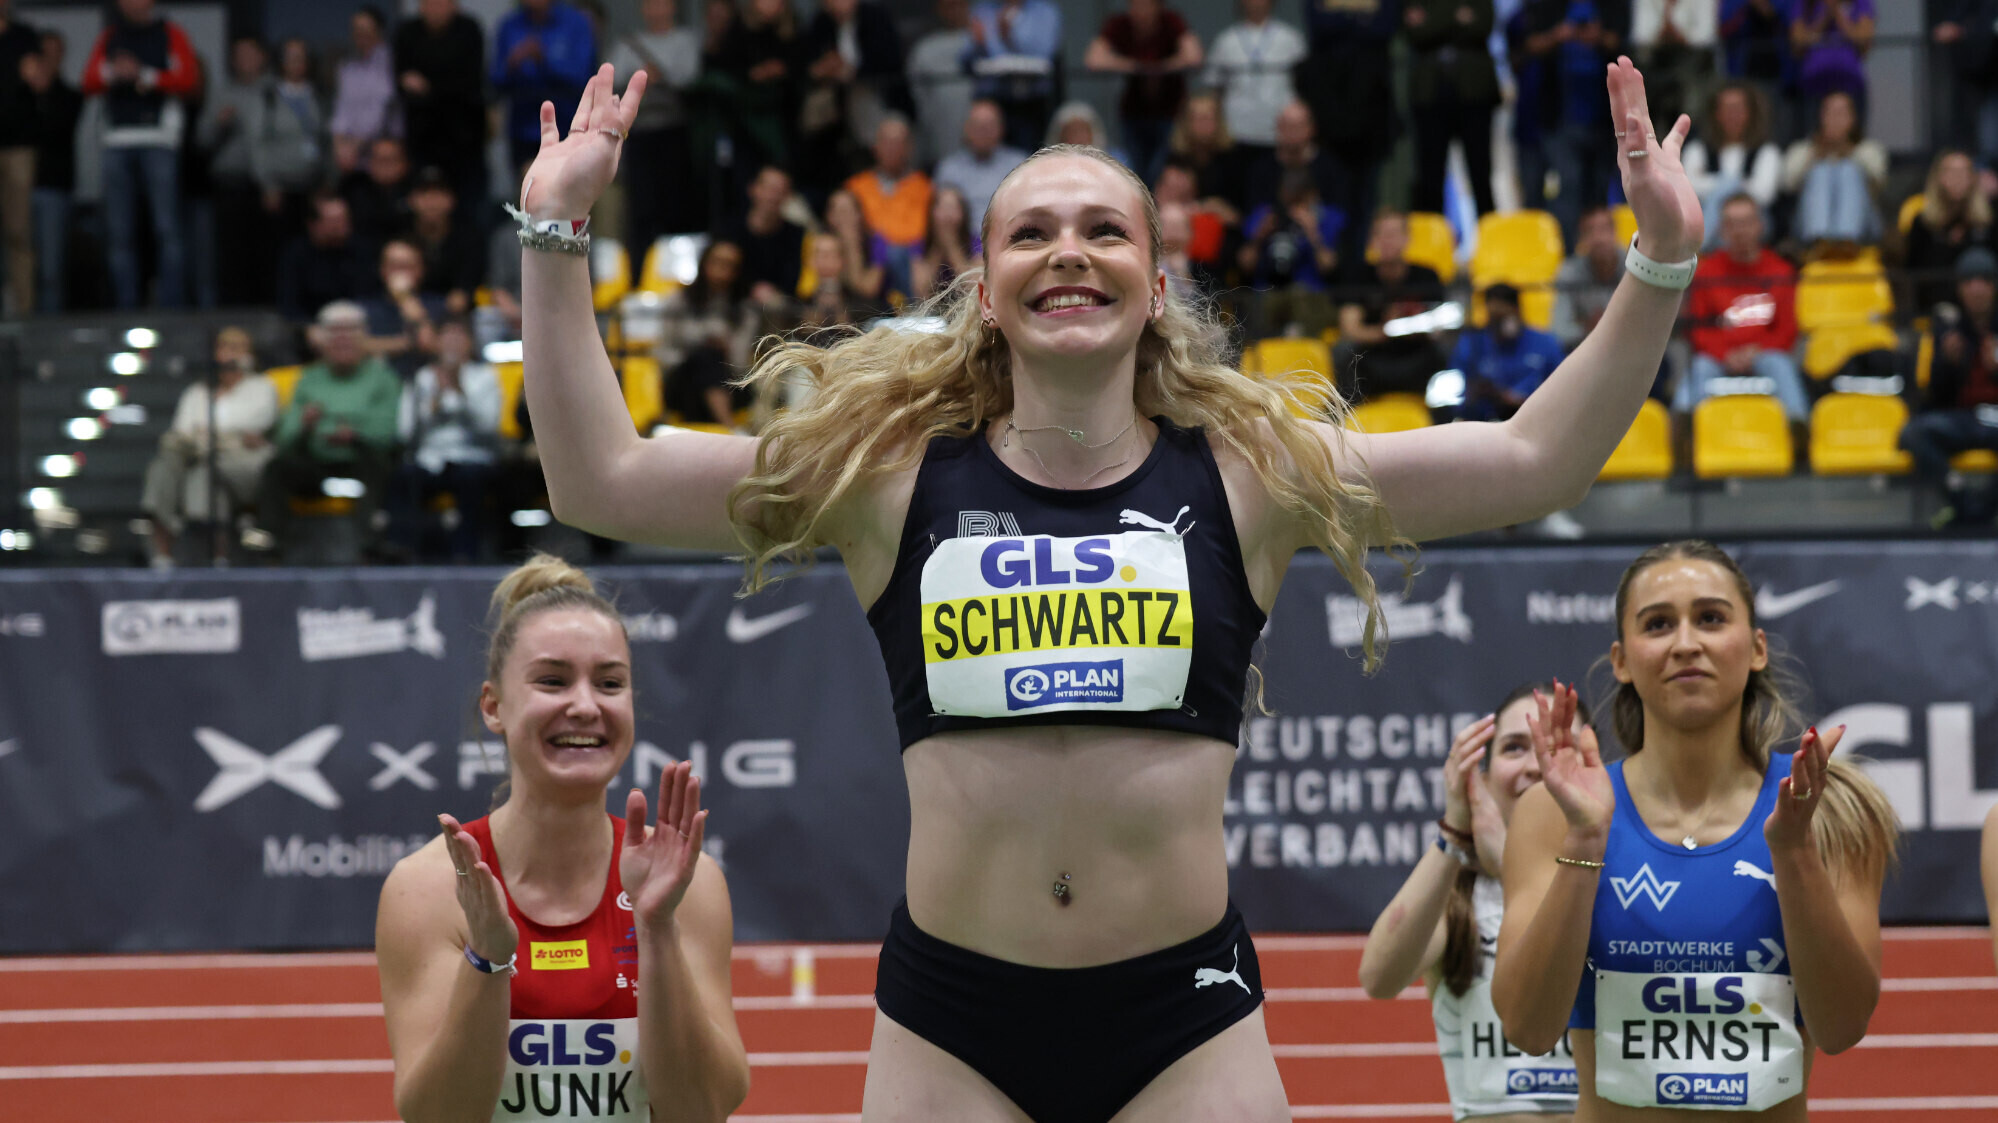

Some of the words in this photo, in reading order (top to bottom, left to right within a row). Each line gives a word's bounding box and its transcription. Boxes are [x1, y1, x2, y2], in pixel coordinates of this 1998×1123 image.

[933, 591, 1181, 660] SCHWARTZ
[1054, 669, 1119, 688] PLAN
[1055, 690, 1118, 698] INTERNATIONAL
[368, 738, 797, 790] XPNG
[549, 948, 584, 959] LOTTO
[1608, 940, 1734, 956] STADTWERKE
[1654, 959, 1735, 973] BOCHUM
[1622, 1020, 1780, 1062] ERNST
[501, 1070, 633, 1117] JUNK
[1694, 1078, 1745, 1094] PLAN
